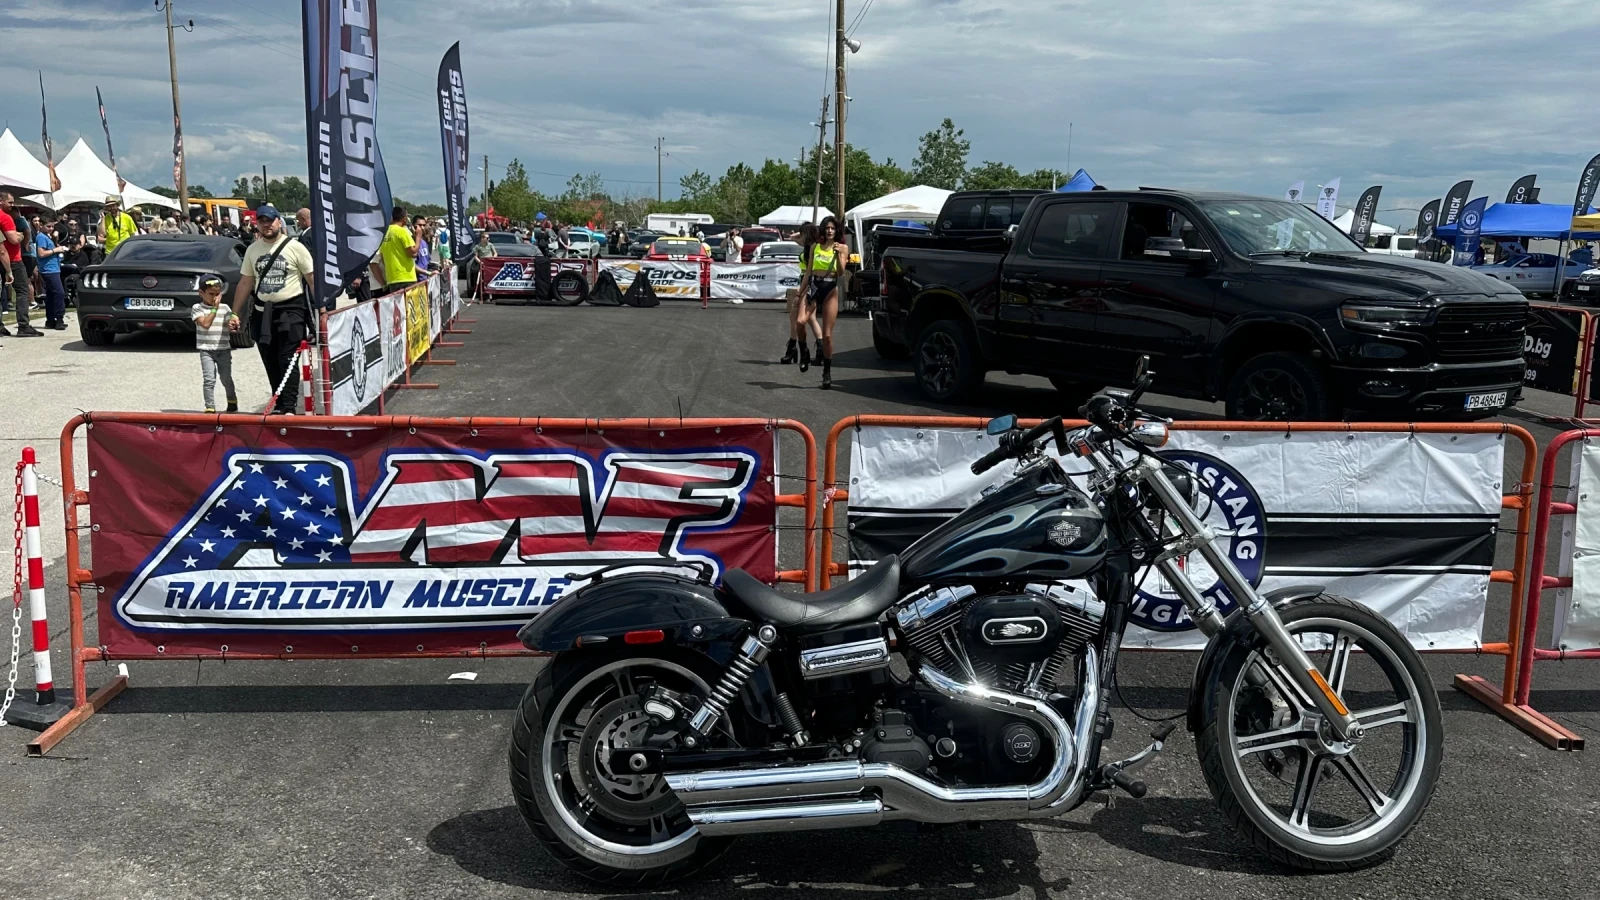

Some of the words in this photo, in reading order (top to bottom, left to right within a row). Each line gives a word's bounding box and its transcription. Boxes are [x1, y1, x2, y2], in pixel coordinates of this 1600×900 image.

[440, 88, 452, 131] Fest
[449, 68, 466, 137] CARS
[318, 121, 342, 287] American
[1446, 197, 1461, 225] TRUCK
[642, 267, 697, 280] Taros
[143, 299, 161, 307] 1308
[1524, 335, 1552, 359] D.bg
[1190, 461, 1258, 560] STANG
[167, 579, 392, 611] AMERICAN
[407, 578, 572, 609] MUSCLE
